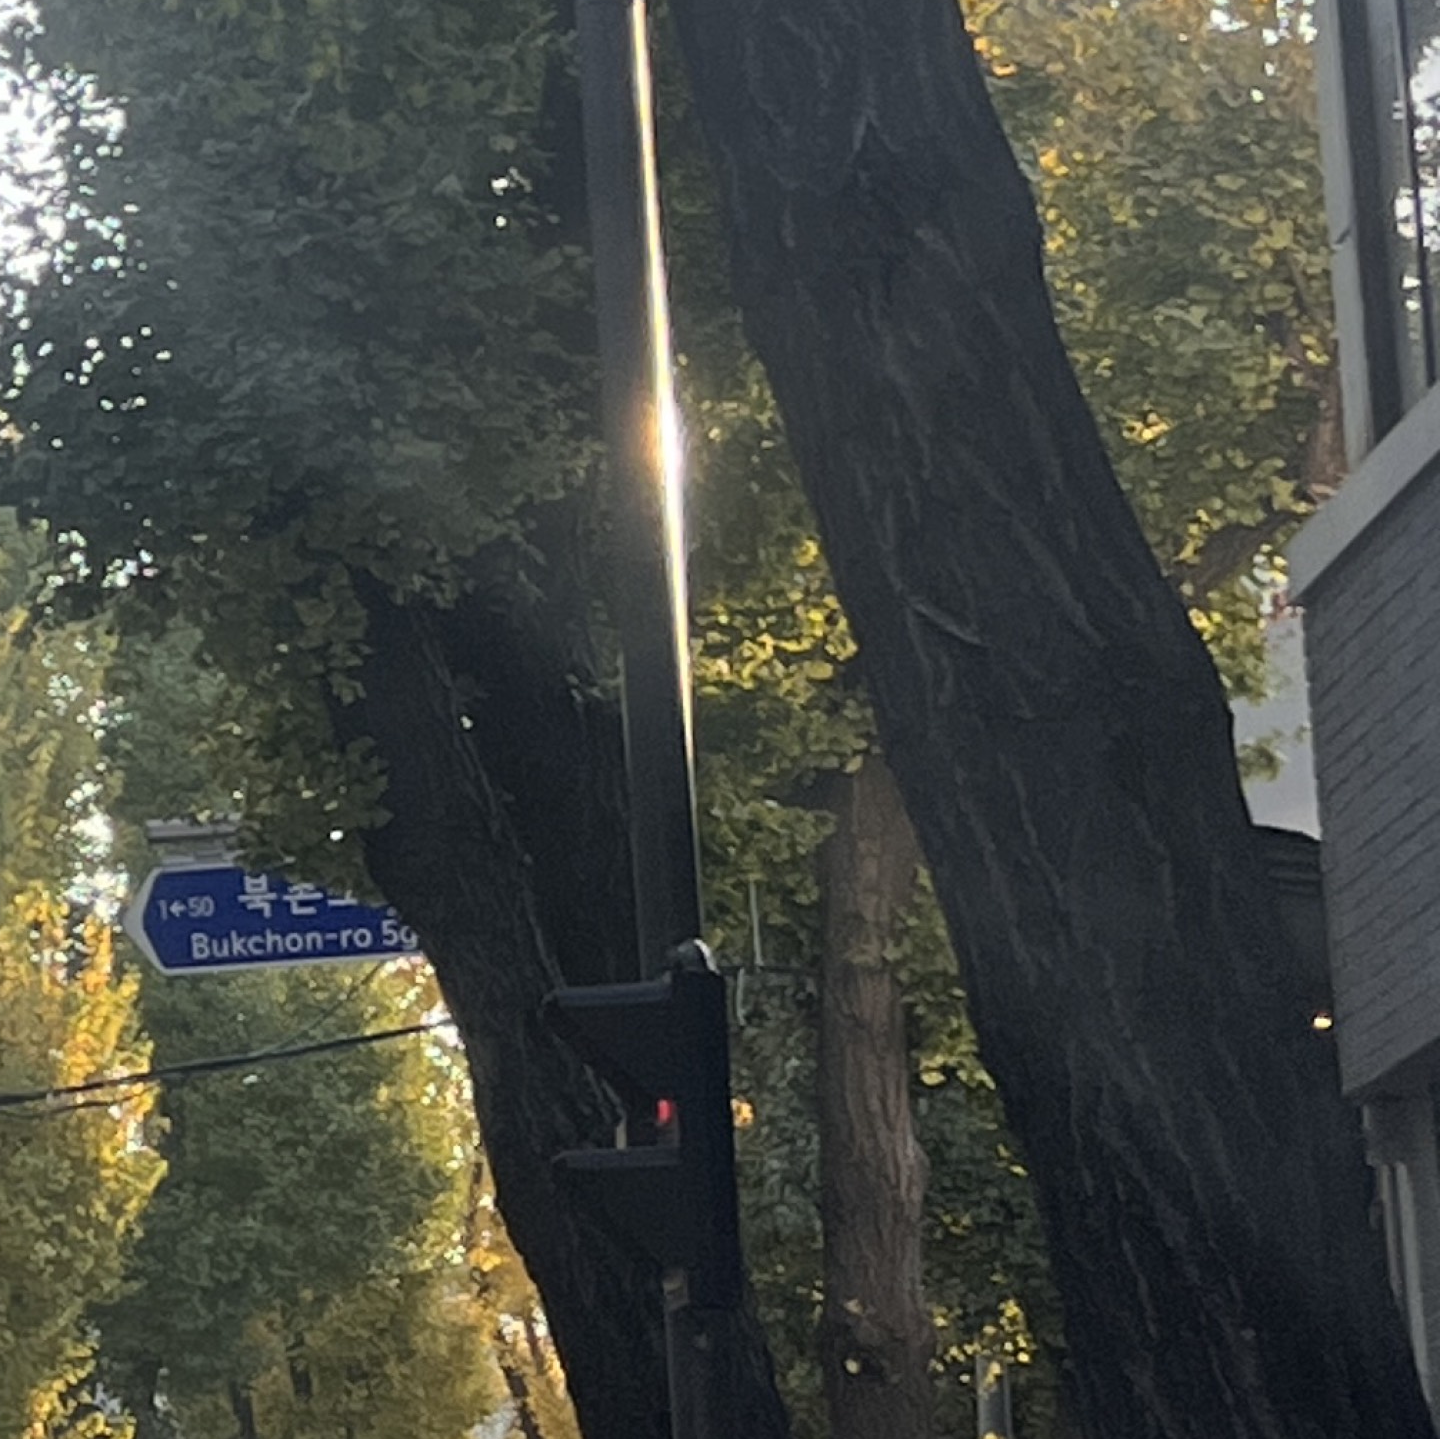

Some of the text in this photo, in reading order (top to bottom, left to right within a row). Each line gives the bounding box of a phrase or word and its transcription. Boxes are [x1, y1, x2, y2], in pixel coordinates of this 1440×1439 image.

[187, 896, 215, 918] 50
[190, 920, 419, 960] Bukchon-ro 5g
